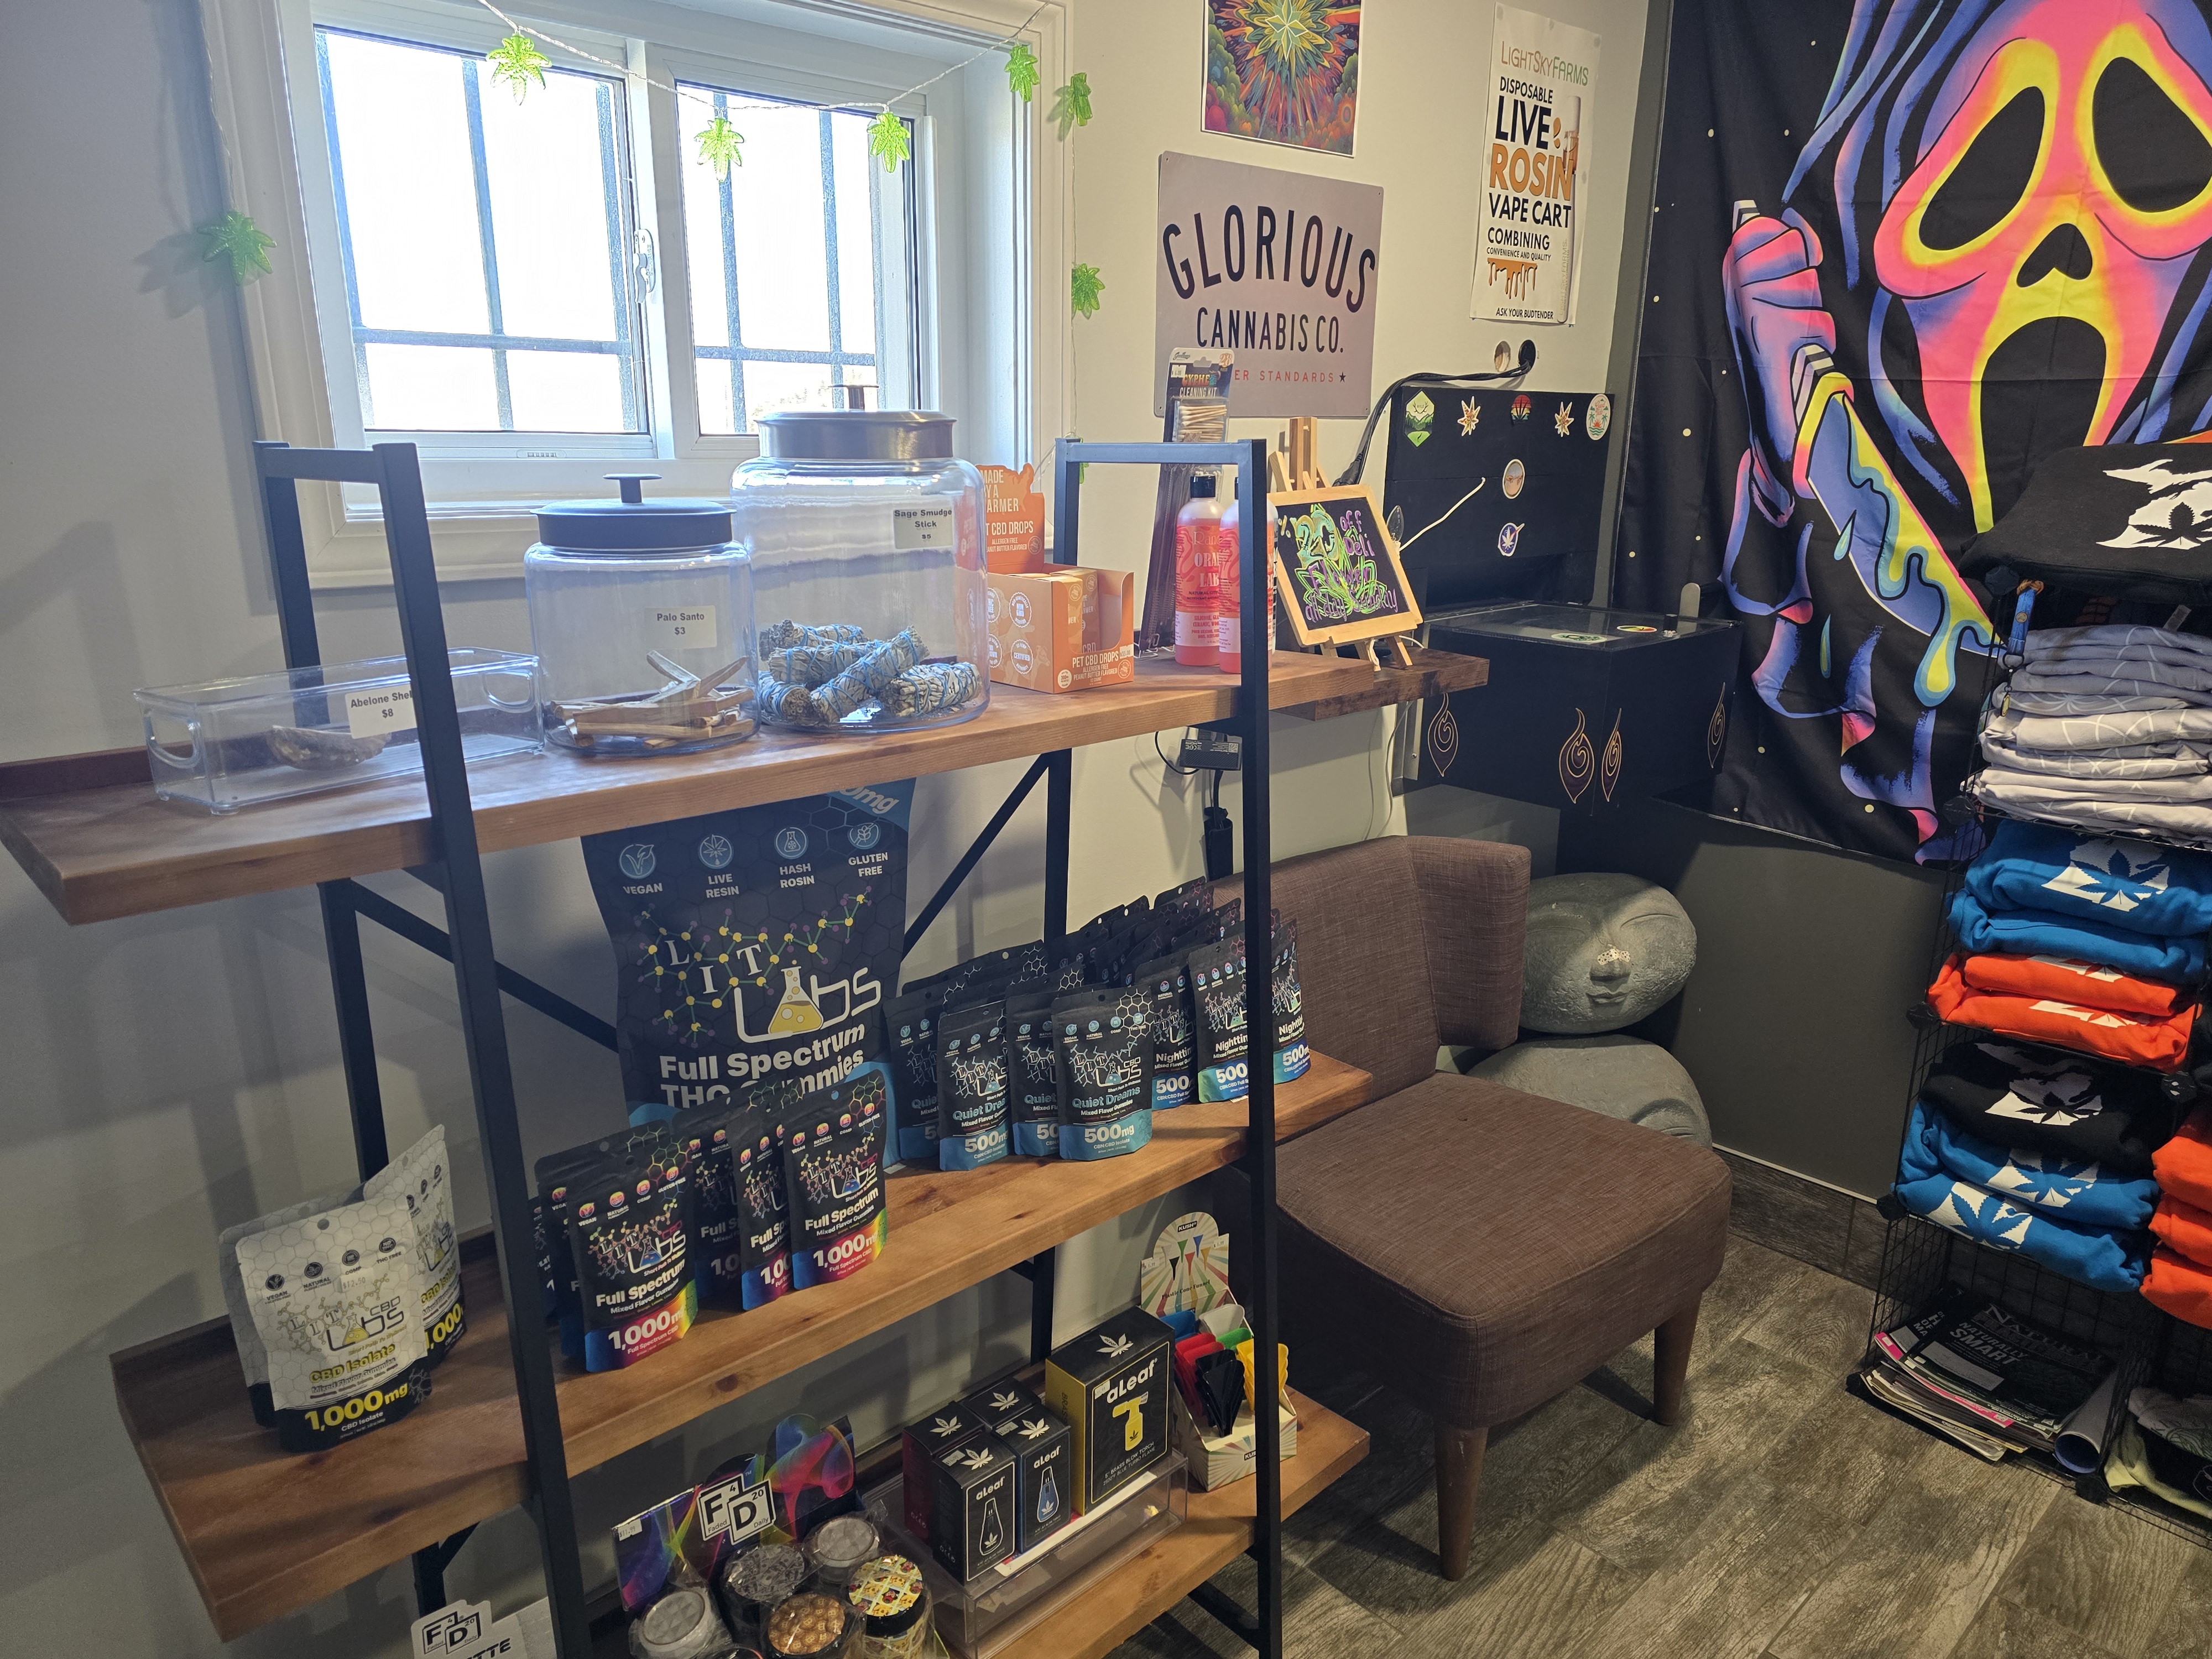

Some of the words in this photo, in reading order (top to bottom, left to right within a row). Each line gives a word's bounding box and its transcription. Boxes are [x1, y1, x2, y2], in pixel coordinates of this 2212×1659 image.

[1500, 76, 1553, 104] DISPOSABLE
[1495, 95, 1552, 150] LIVE
[1489, 142, 1574, 201] ROSIN
[1489, 192, 1529, 223] VAPE
[1532, 200, 1572, 228] CART
[1488, 227, 1550, 251] COMBINING
[1162, 205, 1375, 313] GLORIOUS
[1486, 247, 1520, 258] CONVENIENCE
[1520, 251, 1530, 259] AND
[1531, 252, 1551, 262] QUALITY
[1496, 307, 1507, 317] ASK
[1508, 308, 1524, 318] YOUR
[1524, 309, 1554, 320] BUDTENDER
[1197, 307, 1309, 352] CANNABIS
[1316, 315, 1344, 353] CO.
[1219, 353, 1233, 366] 28
[1260, 371, 1334, 383] STANDARDS
[1180, 387, 1207, 397] CLEANING
[1207, 387, 1217, 397] KIT
[993, 484, 999, 498] A
[894, 510, 917, 518] Sage
[920, 509, 952, 517] Smudge
[992, 522, 1007, 536] CBD
[1009, 520, 1034, 535] DROPS
[1290, 510, 1339, 569] 20
[1343, 533, 1375, 556] Deli
[657, 613, 677, 621] Palo
[674, 627, 686, 635] $3
[1072, 656, 1084, 668] PET
[1085, 654, 1098, 666] CBD
[1099, 651, 1119, 664] DROPS
[1083, 664, 1100, 672] ALLERGEN
[1087, 670, 1100, 679] BUTTER
[1100, 667, 1118, 676] FLAVORED
[351, 696, 389, 708] Abelone
[392, 690, 413, 701] Shel
[382, 708, 394, 718] $8
[847, 852, 889, 867] GLUTEN
[779, 863, 812, 875] HASH
[858, 865, 883, 878] FREE
[707, 873, 734, 885] LIVE
[780, 875, 815, 888] ROSIN
[623, 883, 663, 895] VEGAN
[706, 886, 739, 899] RESIN
[659, 1055, 719, 1081] Full
[727, 1023, 865, 1079] Spectrum
[1123, 1057, 1141, 1068] CBD
[1024, 1093, 1057, 1105] Quiet
[1072, 1096, 1104, 1109] Quiet
[1105, 1087, 1141, 1103] Dreams
[952, 1107, 984, 1121] Quiet
[978, 1115, 994, 1124] Flavor
[1098, 1107, 1114, 1115] Flavor
[1084, 1124, 1135, 1143] 500mg
[792, 1145, 806, 1154] VEGAN
[813, 1135, 832, 1144] NATURAL
[578, 1217, 597, 1227] VEGAN
[607, 1205, 629, 1217] NATURAL
[658, 1177, 686, 1193] GLUTEN-FREE
[805, 1214, 830, 1231] Full
[831, 1187, 879, 1223] Spectrum
[816, 1226, 836, 1237] Mixed
[836, 1218, 853, 1230] Flavor
[853, 1204, 874, 1222] Gummies
[701, 1221, 726, 1238] Full
[750, 1228, 773, 1248] Full
[839, 1254, 862, 1269] Spectrum
[267, 1290, 288, 1301] VEGAN
[303, 1277, 331, 1289] NATURAL
[376, 1256, 388, 1264] THC
[388, 1251, 402, 1260] FREE
[343, 1276, 366, 1289] $12.50
[596, 1291, 625, 1307] Full
[628, 1259, 686, 1300] Spectrum
[1162, 1290, 1179, 1300] Plastic
[1193, 1280, 1211, 1290] Funnel
[369, 1296, 400, 1316] CBD
[610, 1302, 634, 1314] Mixed
[635, 1294, 655, 1308] Flavor
[348, 1345, 364, 1355] Short
[364, 1340, 378, 1349] Path
[627, 1345, 639, 1354] Full
[639, 1332, 667, 1350] Spectrum
[1104, 1338, 1117, 1347] aLeaf
[1950, 1329, 2022, 1365] SMART
[1959, 1322, 2028, 1358] NATURALLY
[309, 1364, 345, 1382] CBD
[346, 1344, 395, 1373] Isolate
[311, 1382, 337, 1394] Mixed
[337, 1373, 362, 1387] Flavor
[362, 1357, 396, 1377] Gummies
[1107, 1360, 1155, 1404] aLeaf
[341, 1421, 358, 1431] CBD
[359, 1411, 384, 1425] Isolate
[1033, 1445, 1061, 1468] aLeaf
[1110, 1461, 1125, 1475] BRASS
[1125, 1452, 1139, 1465] BLOW
[1139, 1442, 1154, 1454] TORCH
[1117, 1466, 1128, 1477] BLUE
[1128, 1455, 1141, 1468] TURBO
[1142, 1446, 1155, 1459] FLAME
[752, 1489, 764, 1501] 20
[976, 1476, 1005, 1500] aLeaf
[704, 1493, 723, 1525] F
[733, 1501, 757, 1531] D
[619, 1526, 636, 1537] $11.99
[707, 1520, 728, 1533] Faded
[753, 1517, 769, 1528] Daily
[464, 1618, 475, 1627] 20
[426, 1624, 442, 1646] F
[449, 1627, 468, 1647] D
[464, 1634, 478, 1644] Daily
